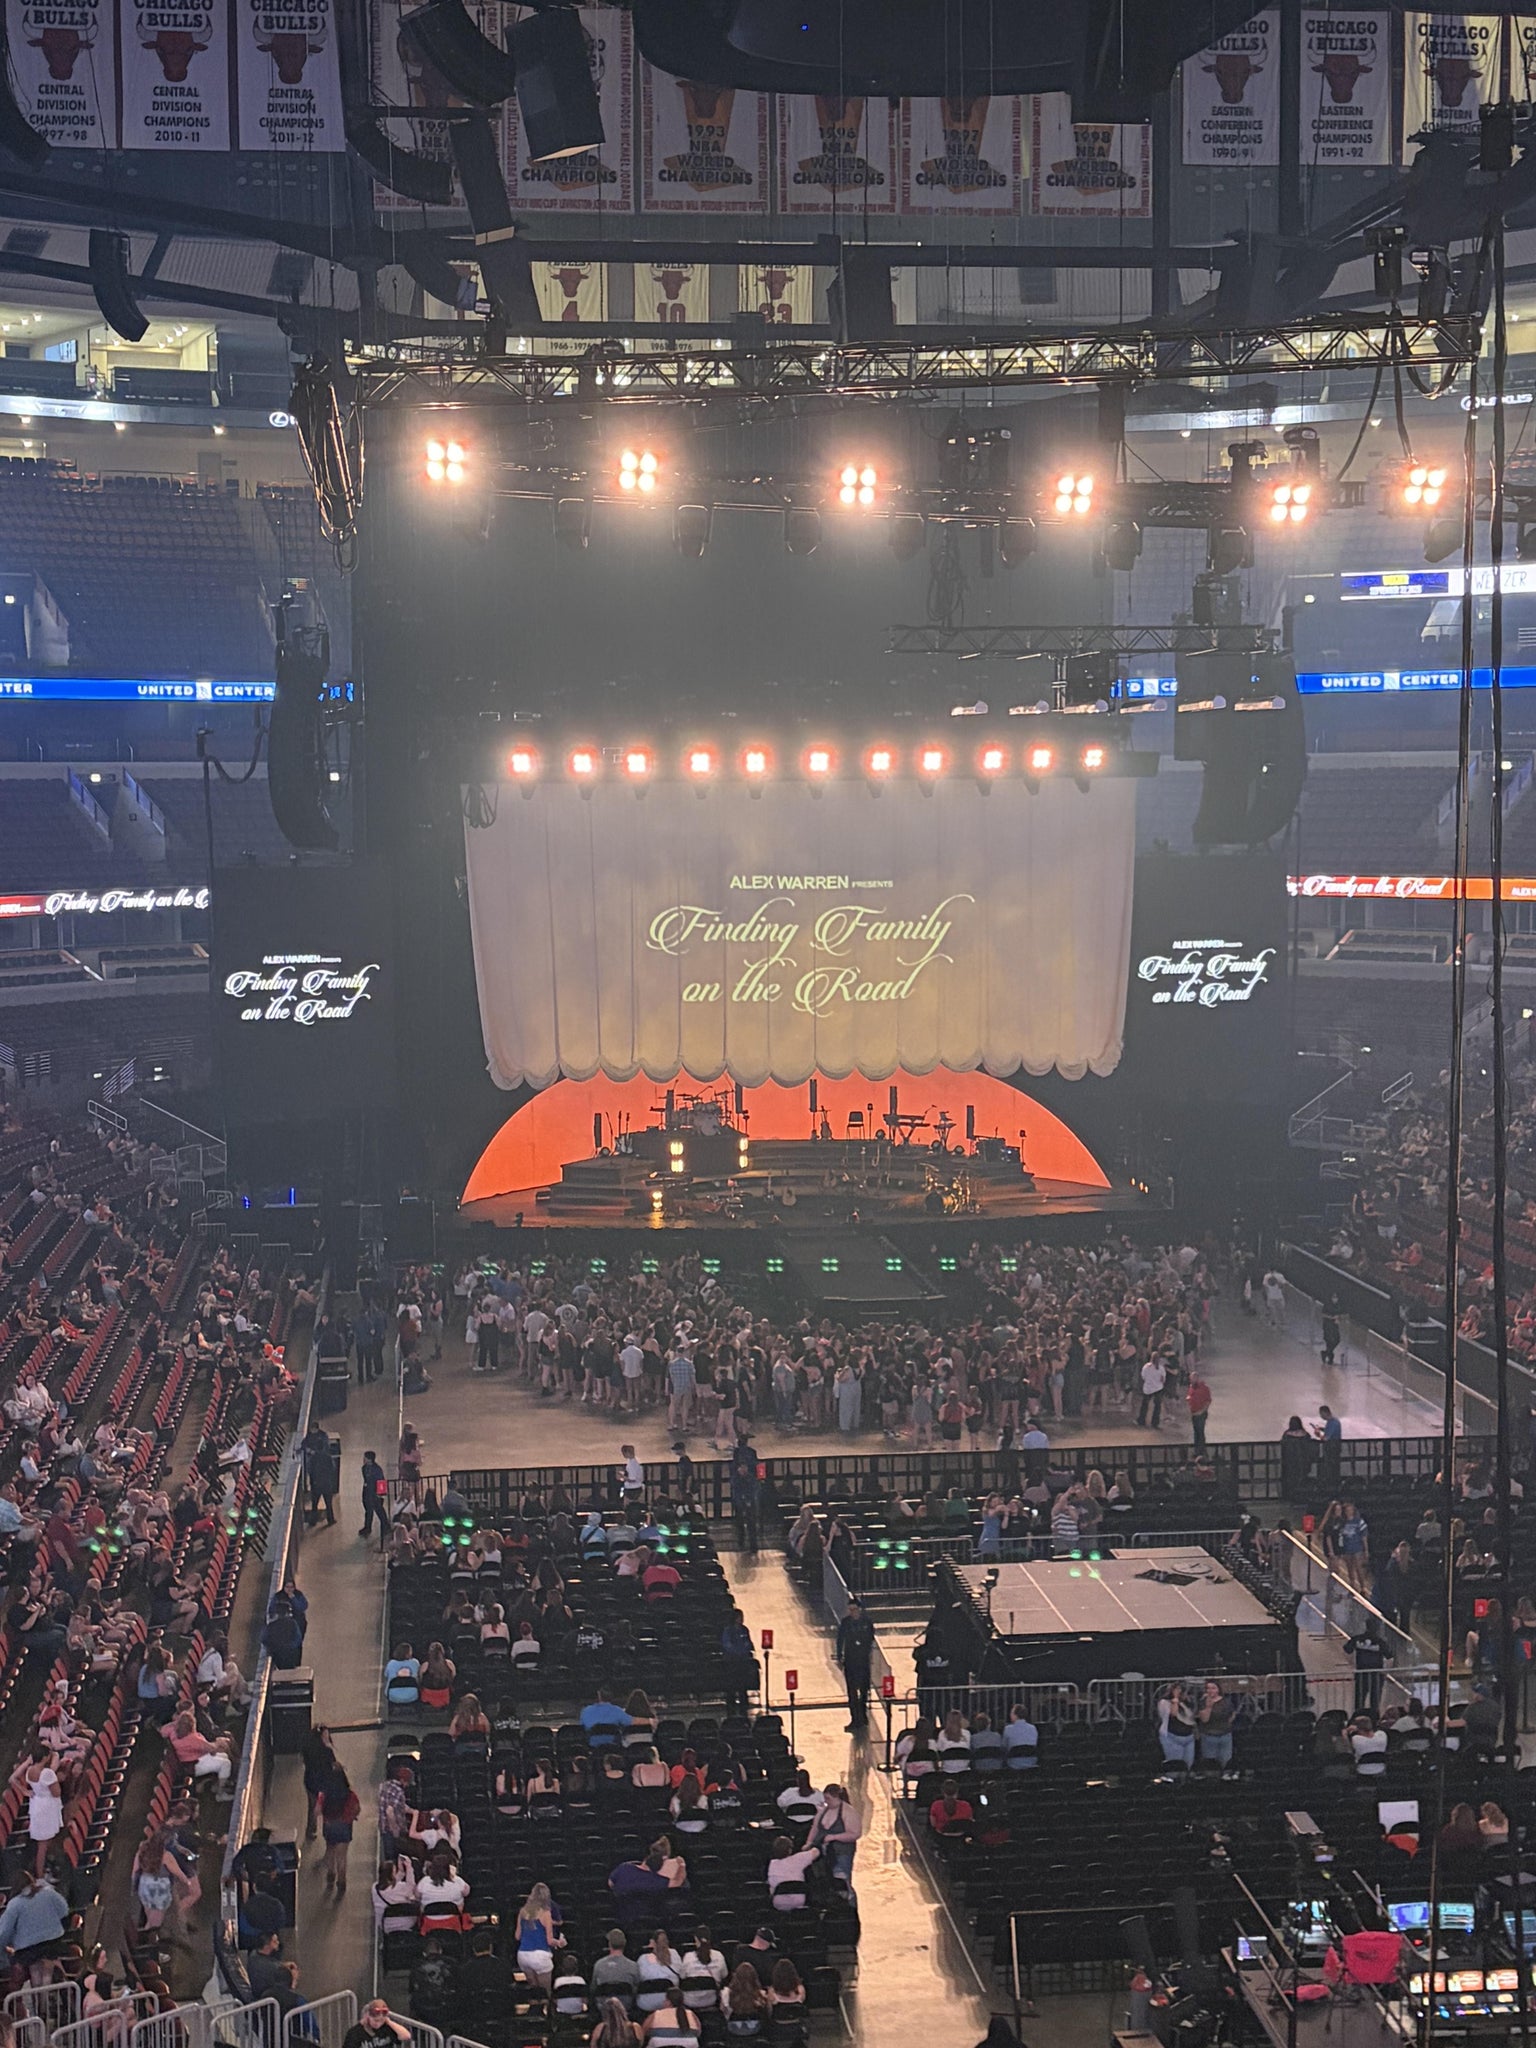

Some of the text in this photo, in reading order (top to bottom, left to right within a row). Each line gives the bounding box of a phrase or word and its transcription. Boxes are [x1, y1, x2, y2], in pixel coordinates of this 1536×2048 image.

[251, 0, 329, 13] CHICAGO
[33, 10, 88, 25] BULLS
[146, 13, 203, 27] BULLS
[263, 15, 318, 30] BULLS
[1305, 20, 1377, 34] CHICAGO
[1418, 23, 1489, 39] CHICAGO
[1209, 37, 1259, 50] ULLS
[1317, 37, 1368, 51] BULLS
[38, 84, 84, 95] CENTRAL
[153, 86, 199, 98] CENTRAL
[37, 99, 86, 110] DIVISION
[152, 101, 202, 113] DIVISION
[267, 102, 316, 113] DIVISION
[1211, 106, 1254, 116] EASTERN
[1321, 106, 1363, 116] EASTERN
[29, 114, 96, 126] CHAMPIONS
[144, 116, 210, 128] CHAMPIONS
[259, 117, 325, 129] CHAMPIONS
[1201, 120, 1263, 130] CONFERENCE
[1311, 120, 1373, 130] CONFERENCE
[688, 124, 724, 137] 1993
[819, 127, 856, 140] 1996
[1073, 131, 1110, 143] 1998
[1203, 133, 1263, 145] CHAMPIONS
[1312, 133, 1373, 145] CHAMPIONS
[689, 140, 721, 153] NBA
[822, 142, 855, 155] NBA
[946, 144, 977, 156] NBA
[1076, 146, 1106, 158] NBA
[676, 155, 735, 168] WORLD
[811, 157, 867, 170] WORLD
[934, 159, 989, 171] WORLD
[1064, 161, 1118, 173] WORLD
[521, 168, 617, 183] CHAMPIONS
[658, 170, 753, 185] CHAMPIONS
[793, 172, 885, 187] CHAMPIONS
[915, 173, 1007, 188] CHAMPIONS
[1046, 174, 1137, 189] CHAMPIONS
[657, 303, 686, 322] 10
[1475, 571, 1527, 590] WEZER
[1322, 674, 1459, 688] UNITED CENTER
[138, 685, 275, 697] UNITED CENTER
[730, 876, 893, 889] ALEX WARREN PRESENTS
[646, 894, 975, 966] Finding Family
[263, 955, 284, 964] ALEX
[285, 955, 320, 963] WARREN
[1138, 948, 1277, 984] Finding Family
[224, 964, 380, 1000] Finding Family
[682, 954, 953, 1017] on the Road
[1173, 979, 1203, 1003] the
[1199, 977, 1268, 1008] Road
[241, 994, 371, 1025] on the Road
